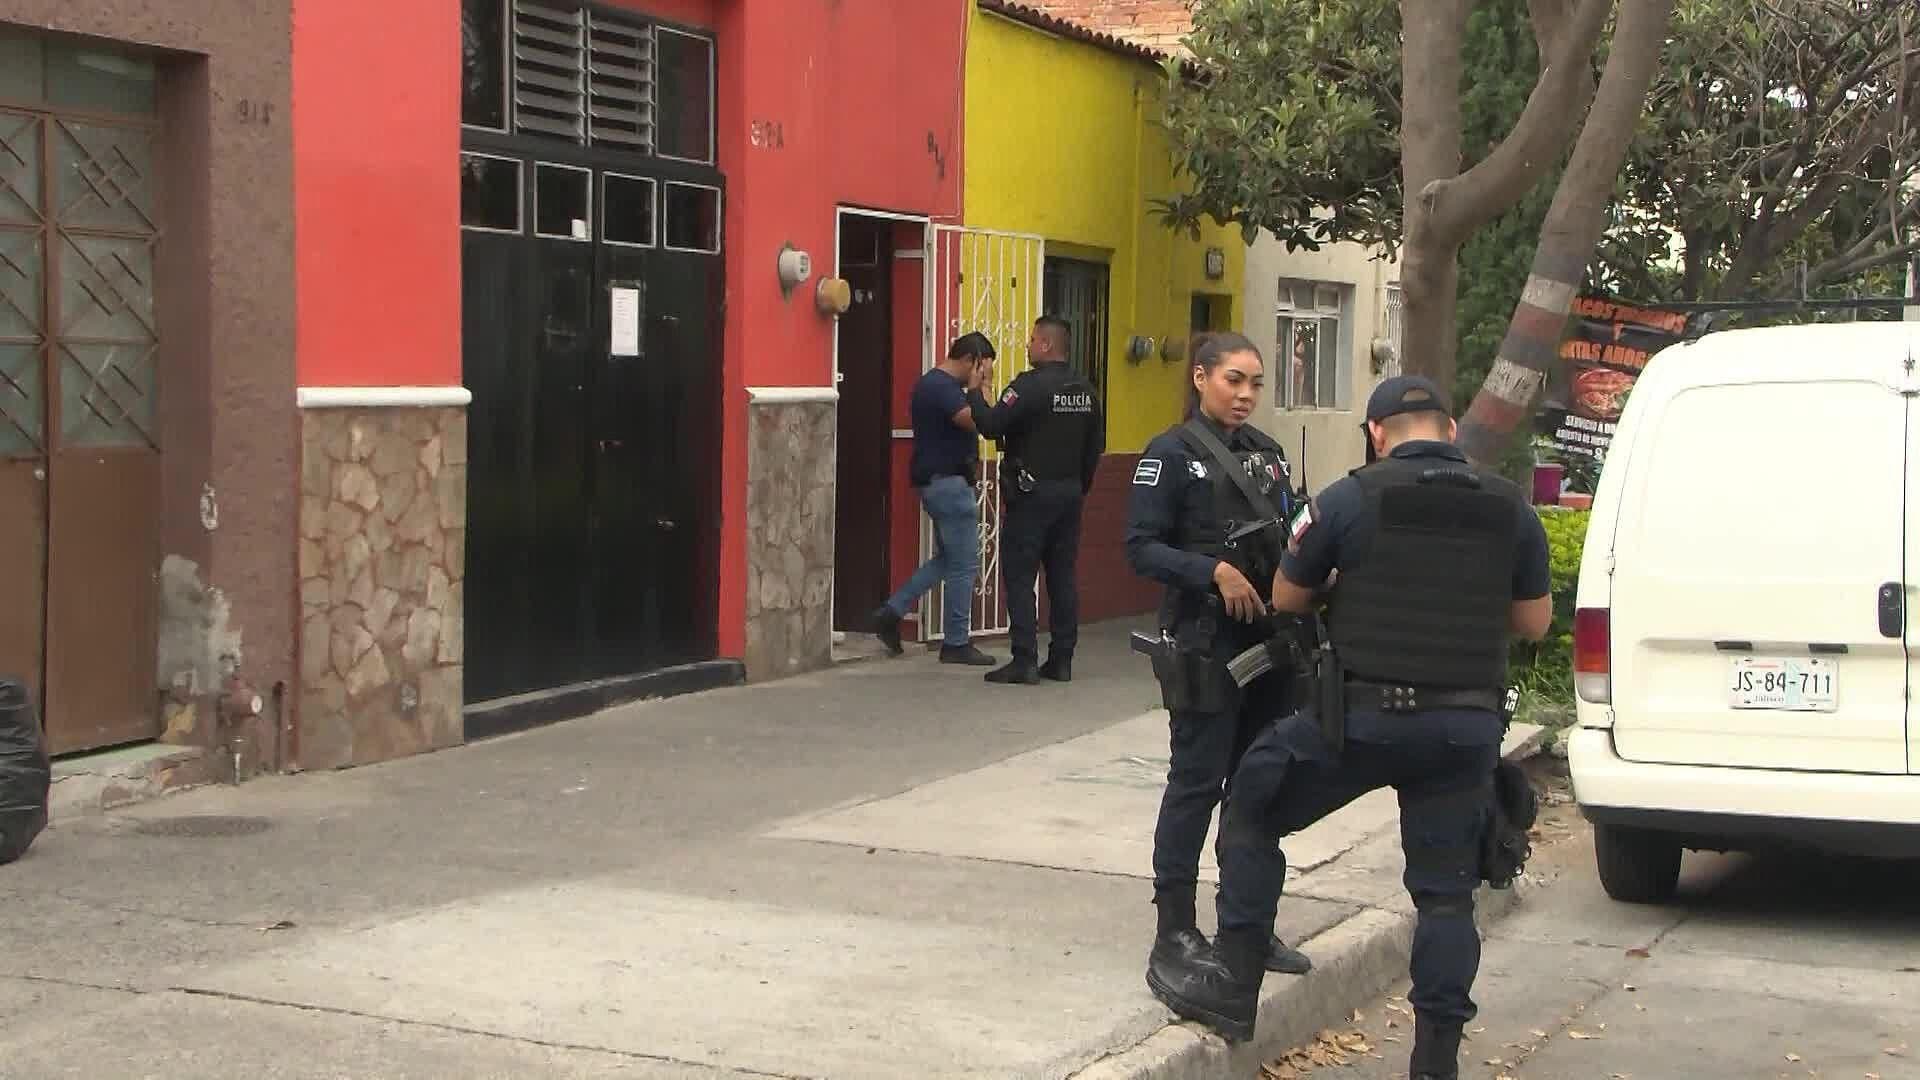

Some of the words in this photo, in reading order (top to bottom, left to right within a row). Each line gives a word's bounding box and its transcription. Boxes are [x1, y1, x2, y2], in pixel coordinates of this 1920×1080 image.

[1570, 296, 1617, 320] ACOS
[1053, 392, 1091, 406] POLICÍA
[1732, 671, 1832, 694] JS-84-711
